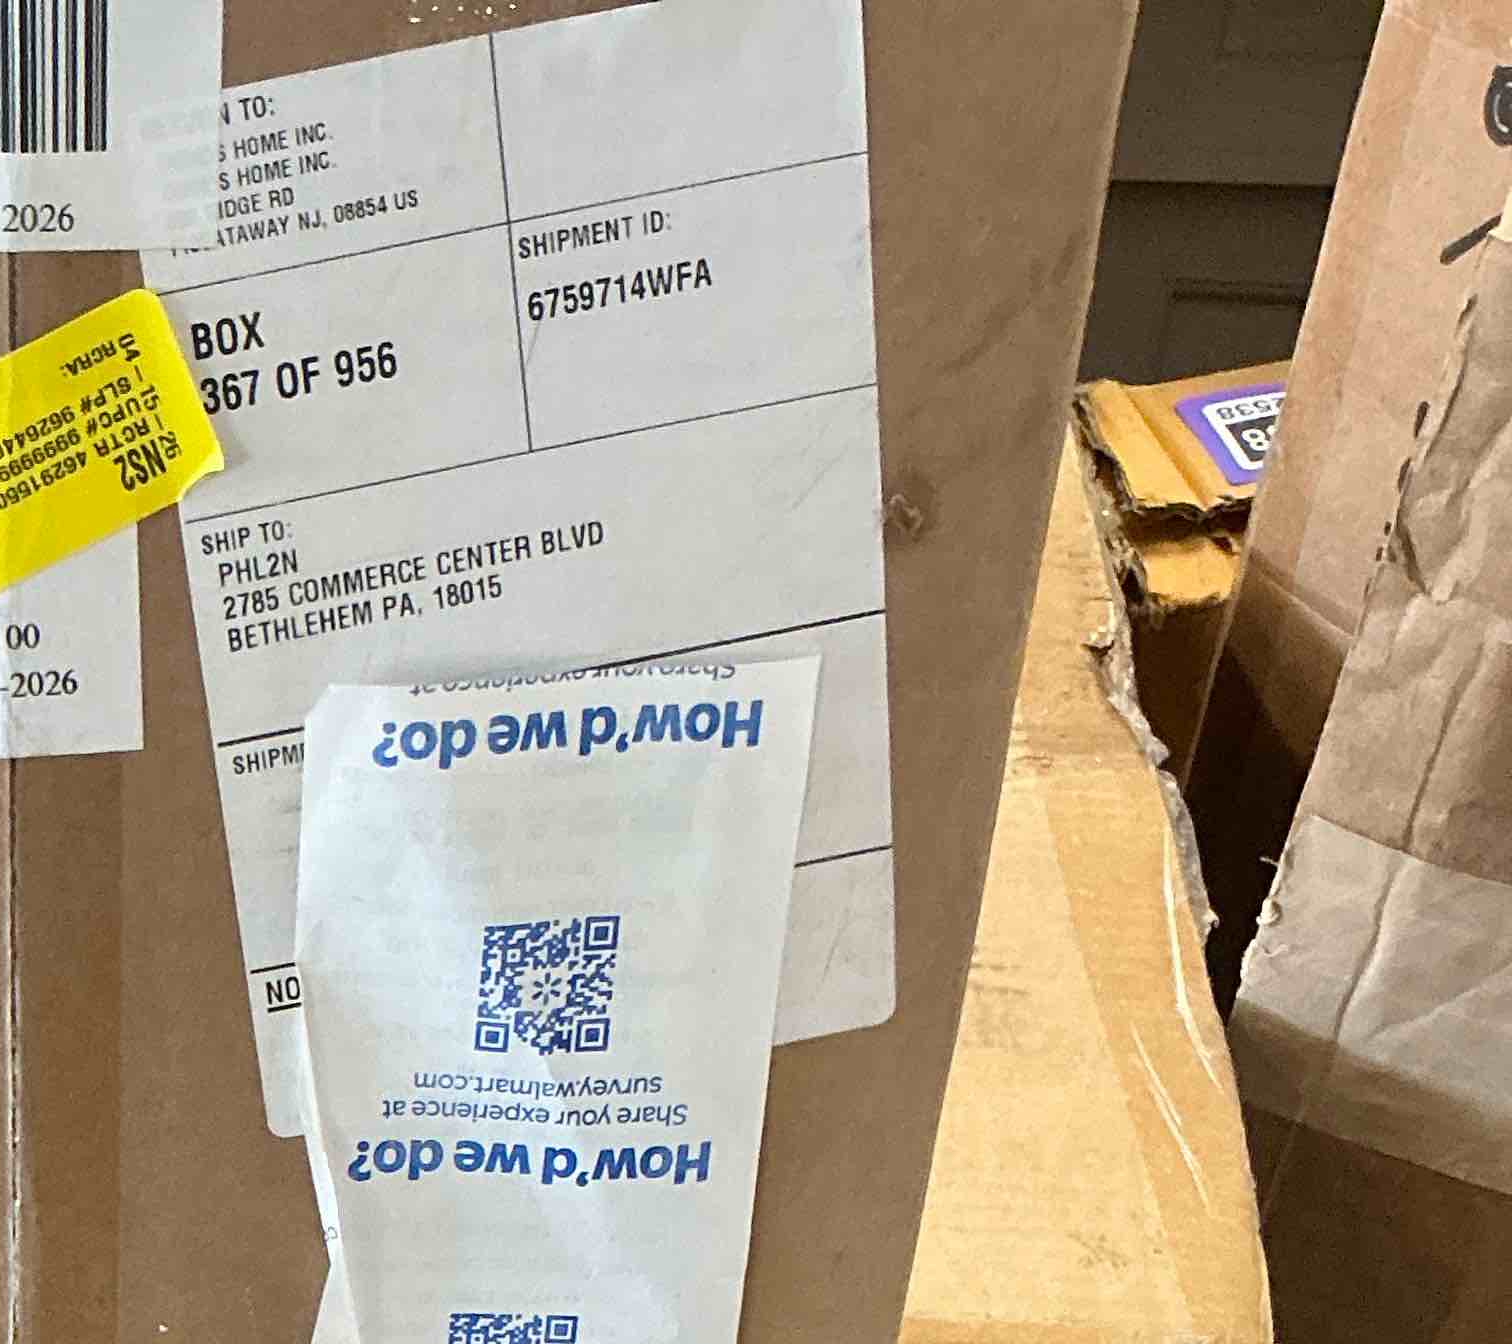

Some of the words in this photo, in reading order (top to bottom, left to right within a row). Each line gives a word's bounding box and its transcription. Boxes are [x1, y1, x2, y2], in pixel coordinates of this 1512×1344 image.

[238, 96, 275, 121] TO:
[232, 130, 289, 159] HOME
[295, 122, 334, 147] INC.
[237, 158, 294, 187] HOME
[299, 151, 338, 175] INC.
[217, 193, 264, 220] IDGE
[268, 187, 296, 209] RD
[333, 195, 388, 224] 08854
[392, 189, 420, 212] US
[517, 216, 633, 260] SHIPMENT
[642, 210, 672, 235] ID:
[526, 257, 714, 322] 6759714WFA
[191, 311, 265, 361] BOX
[201, 367, 260, 414] 367
[276, 357, 321, 399] OF
[335, 341, 398, 387] 956
[118, 440, 168, 493] NS2
[201, 524, 252, 556] SHIP
[259, 519, 293, 545] TO:
[218, 548, 299, 587] PHL2N
[223, 585, 281, 621] 2785
[288, 557, 426, 610] COMMERCE
[437, 535, 533, 578] CENTER
[541, 520, 605, 556] BLVD
[227, 600, 374, 654] BETHLEHEM
[433, 574, 504, 610] 18015
[6, 622, 40, 650] 00
[372, 719, 477, 769] do?
[488, 713, 571, 756] we
[581, 699, 764, 756] How'd
[233, 743, 306, 776] SHIPM
[413, 1071, 662, 1097] survey.walmart.com
[381, 1099, 406, 1118] at
[410, 1100, 550, 1127] experience
[555, 1104, 613, 1127] your
[617, 1103, 688, 1127] Share
[347, 1139, 444, 1184] do?
[454, 1143, 530, 1178] we
[541, 1140, 712, 1186] How'd
